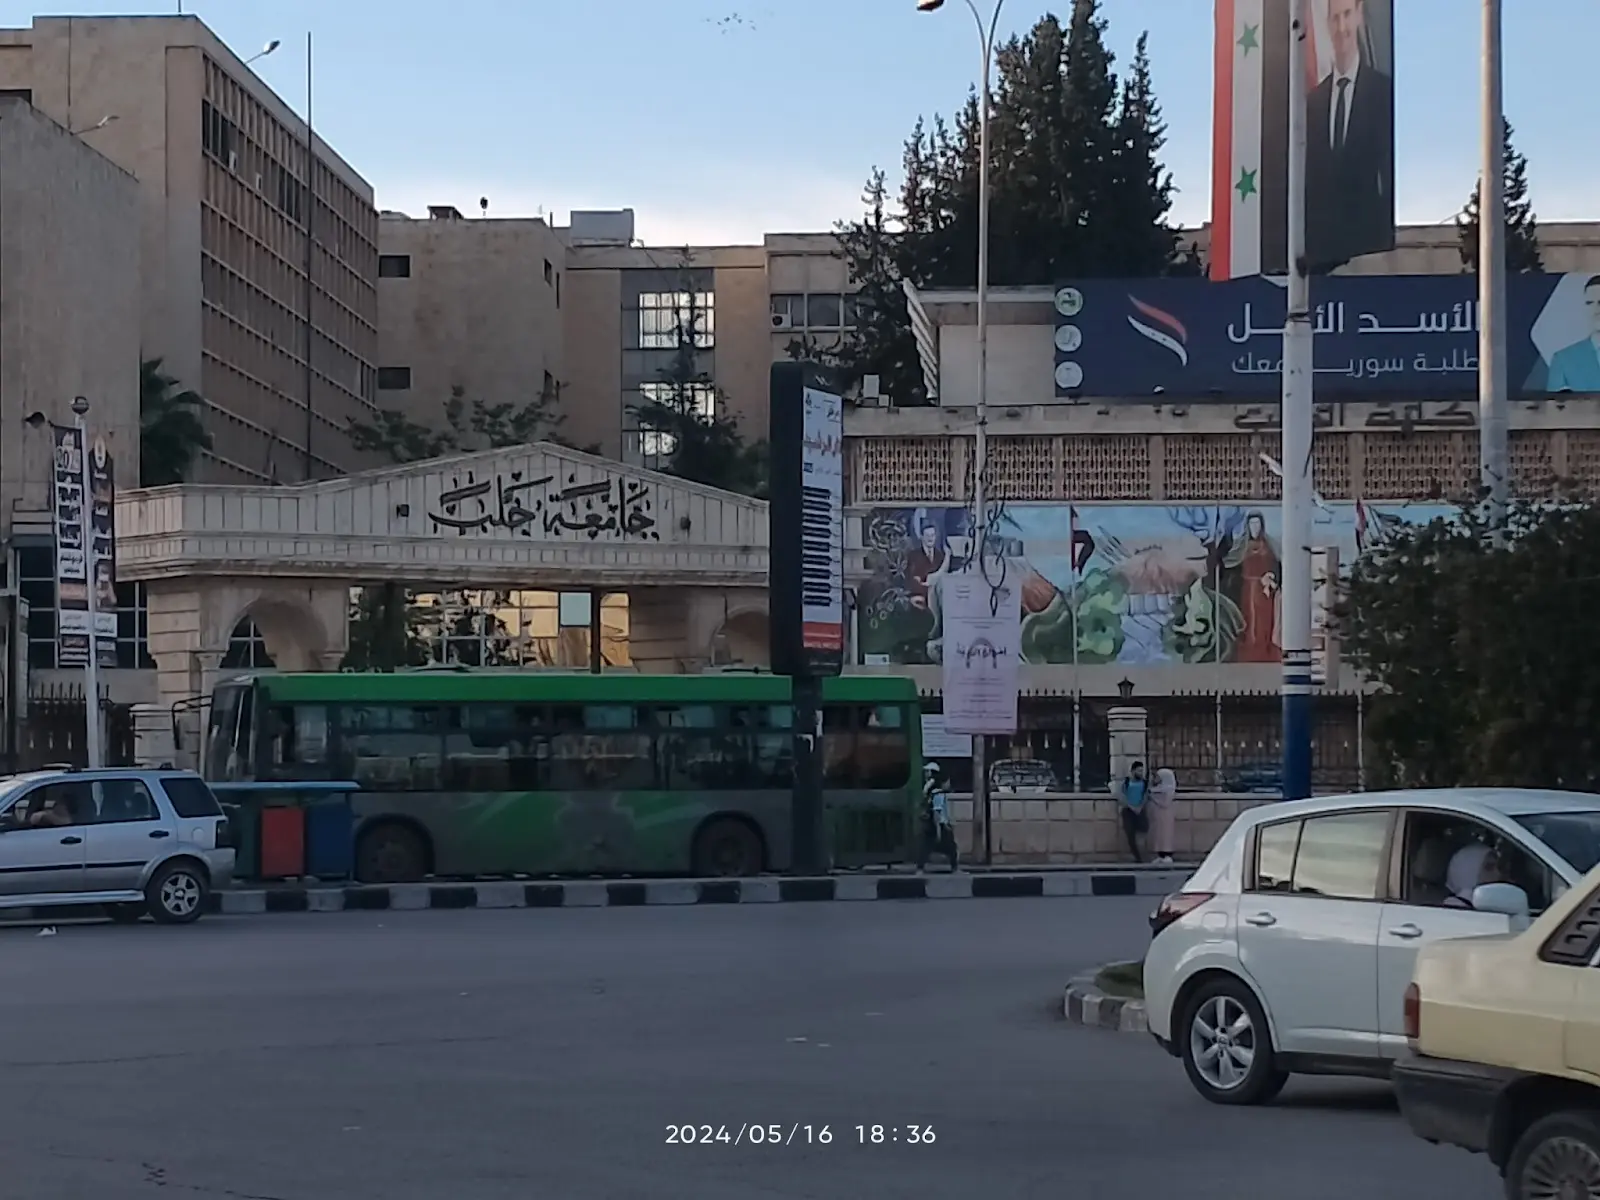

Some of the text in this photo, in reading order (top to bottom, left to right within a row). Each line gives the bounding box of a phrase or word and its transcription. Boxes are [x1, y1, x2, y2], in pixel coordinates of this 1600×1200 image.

[1227, 301, 1345, 344] الأل
[1312, 354, 1404, 378] سوري
[1413, 348, 1479, 375] طلبة
[428, 470, 660, 541] جامعة حلب
